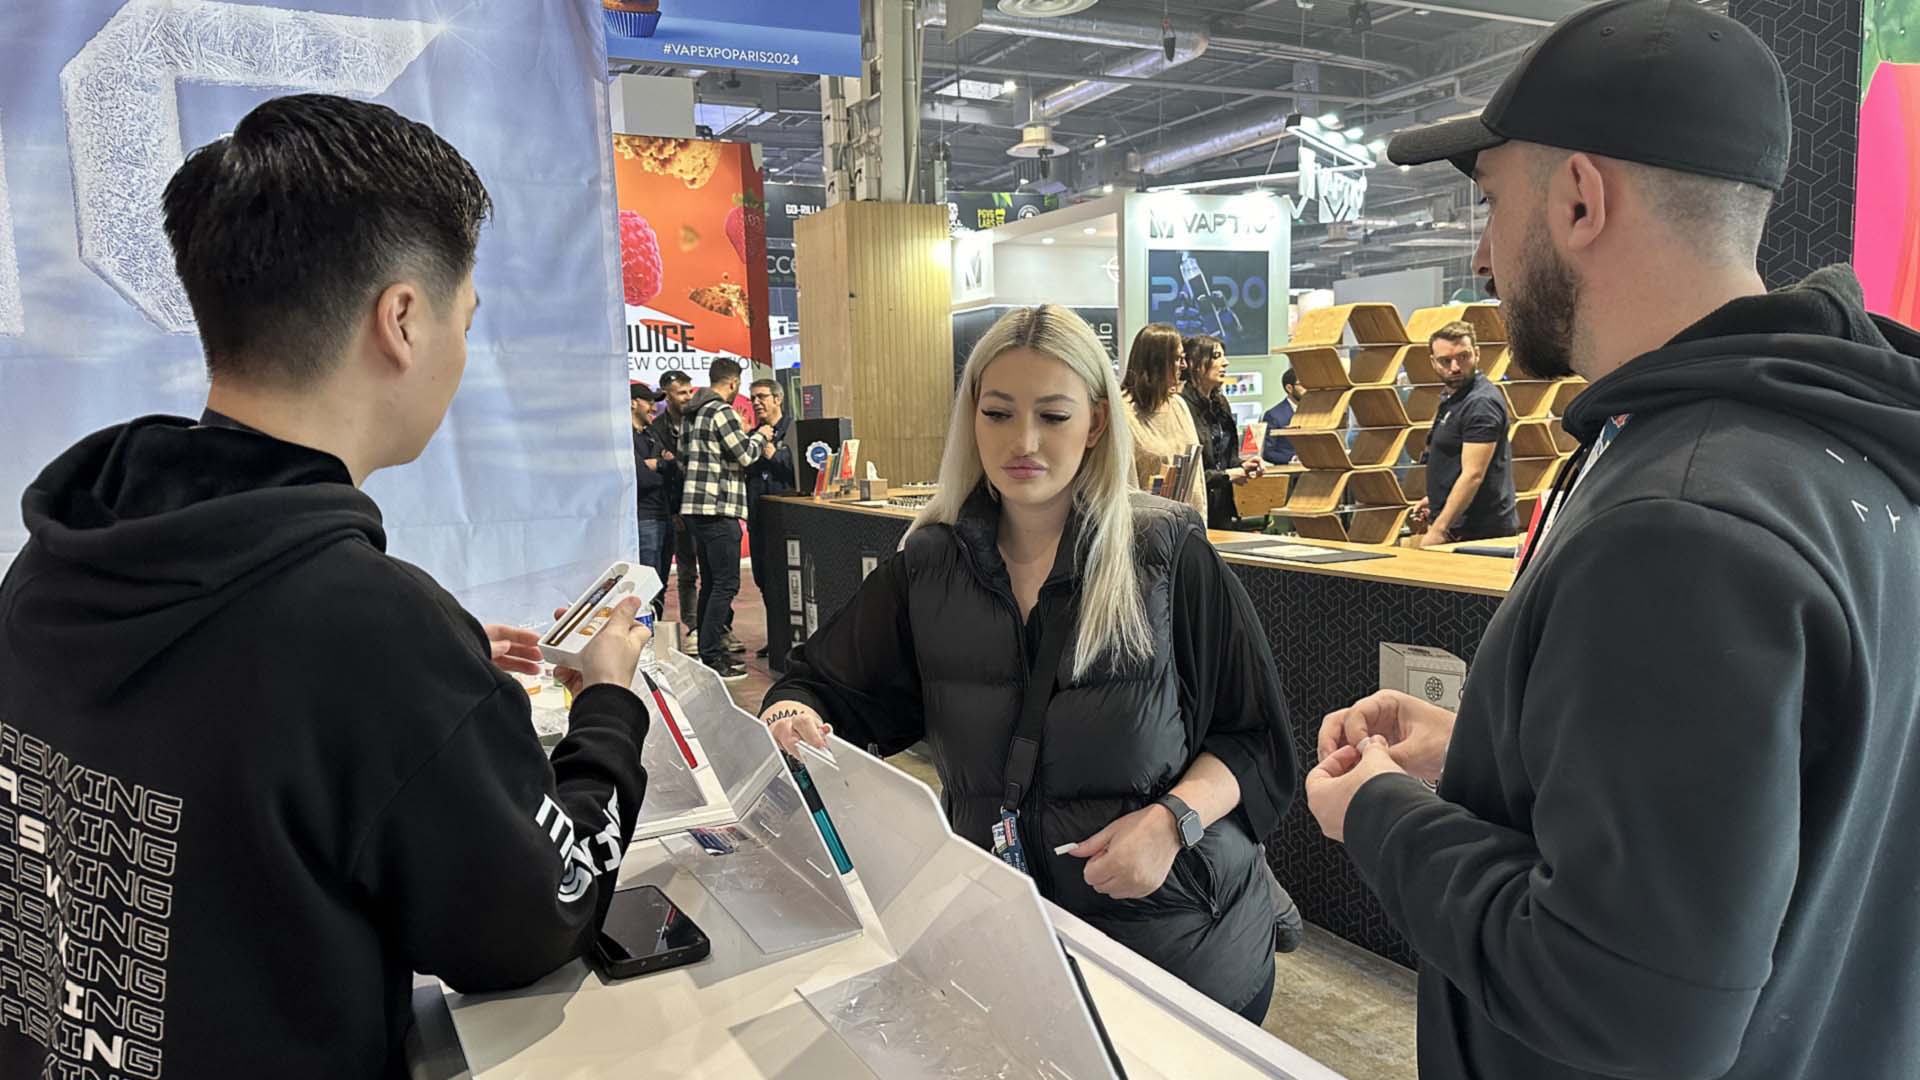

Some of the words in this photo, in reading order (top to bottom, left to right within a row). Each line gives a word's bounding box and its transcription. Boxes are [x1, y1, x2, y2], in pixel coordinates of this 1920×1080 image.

[663, 42, 800, 66] #VAPEXPOPARIS2024
[1151, 275, 1267, 311] PDO
[628, 356, 650, 370] EW
